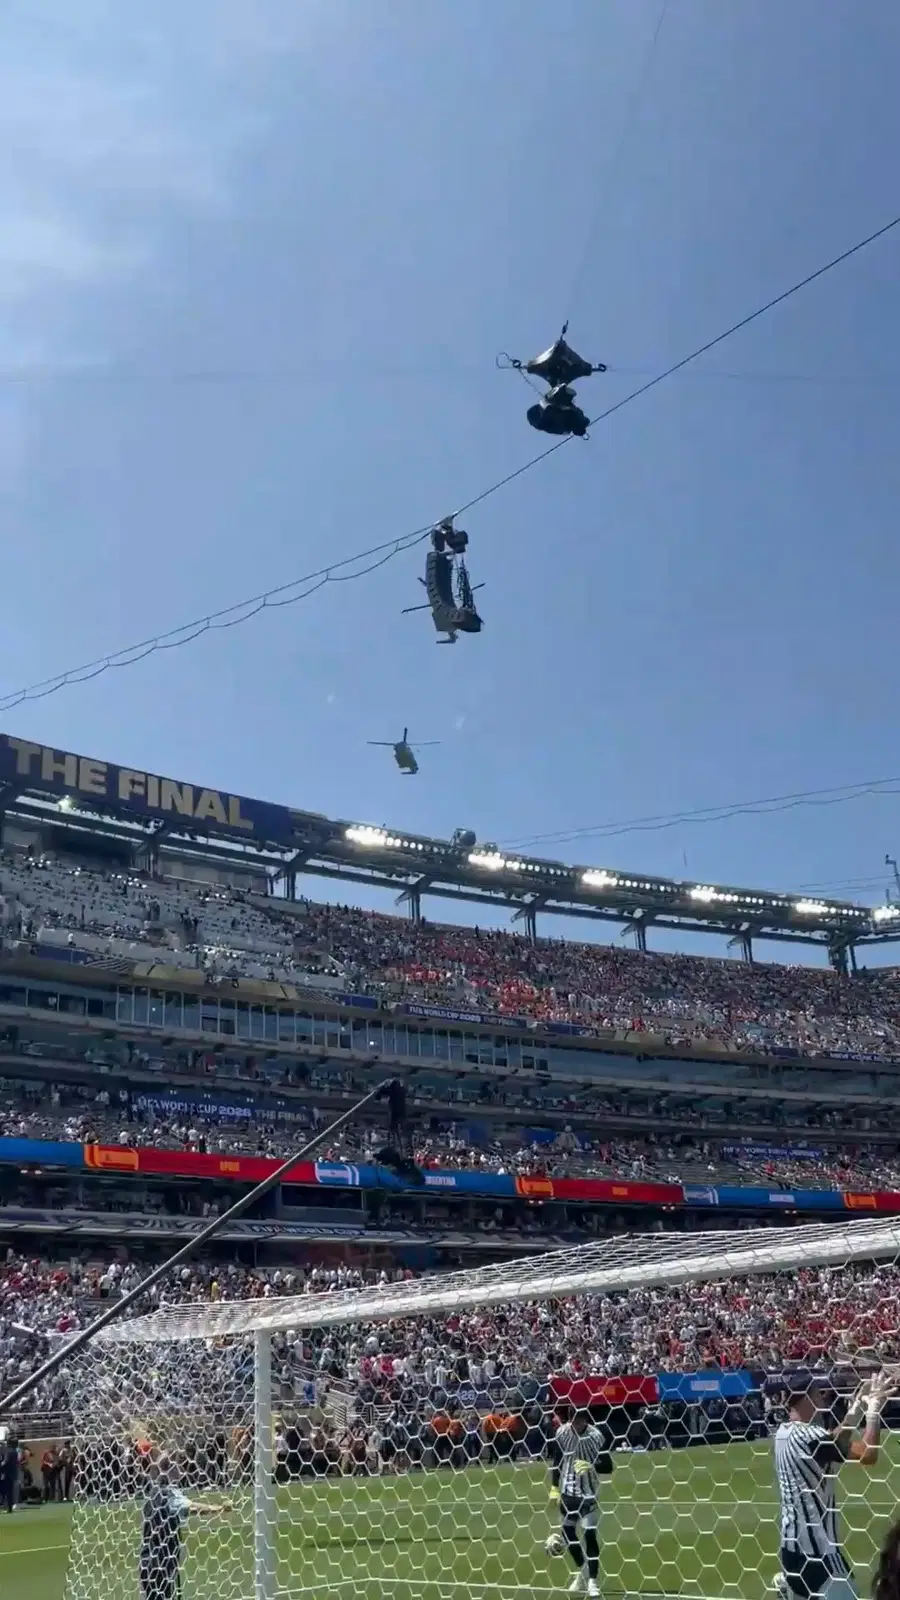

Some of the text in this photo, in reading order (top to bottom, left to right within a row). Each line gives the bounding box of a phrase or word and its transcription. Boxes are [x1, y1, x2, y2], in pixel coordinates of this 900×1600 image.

[8, 737, 254, 830] THE FINAL
[199, 1103, 217, 1114] CUP
[219, 1106, 251, 1117] 2026
